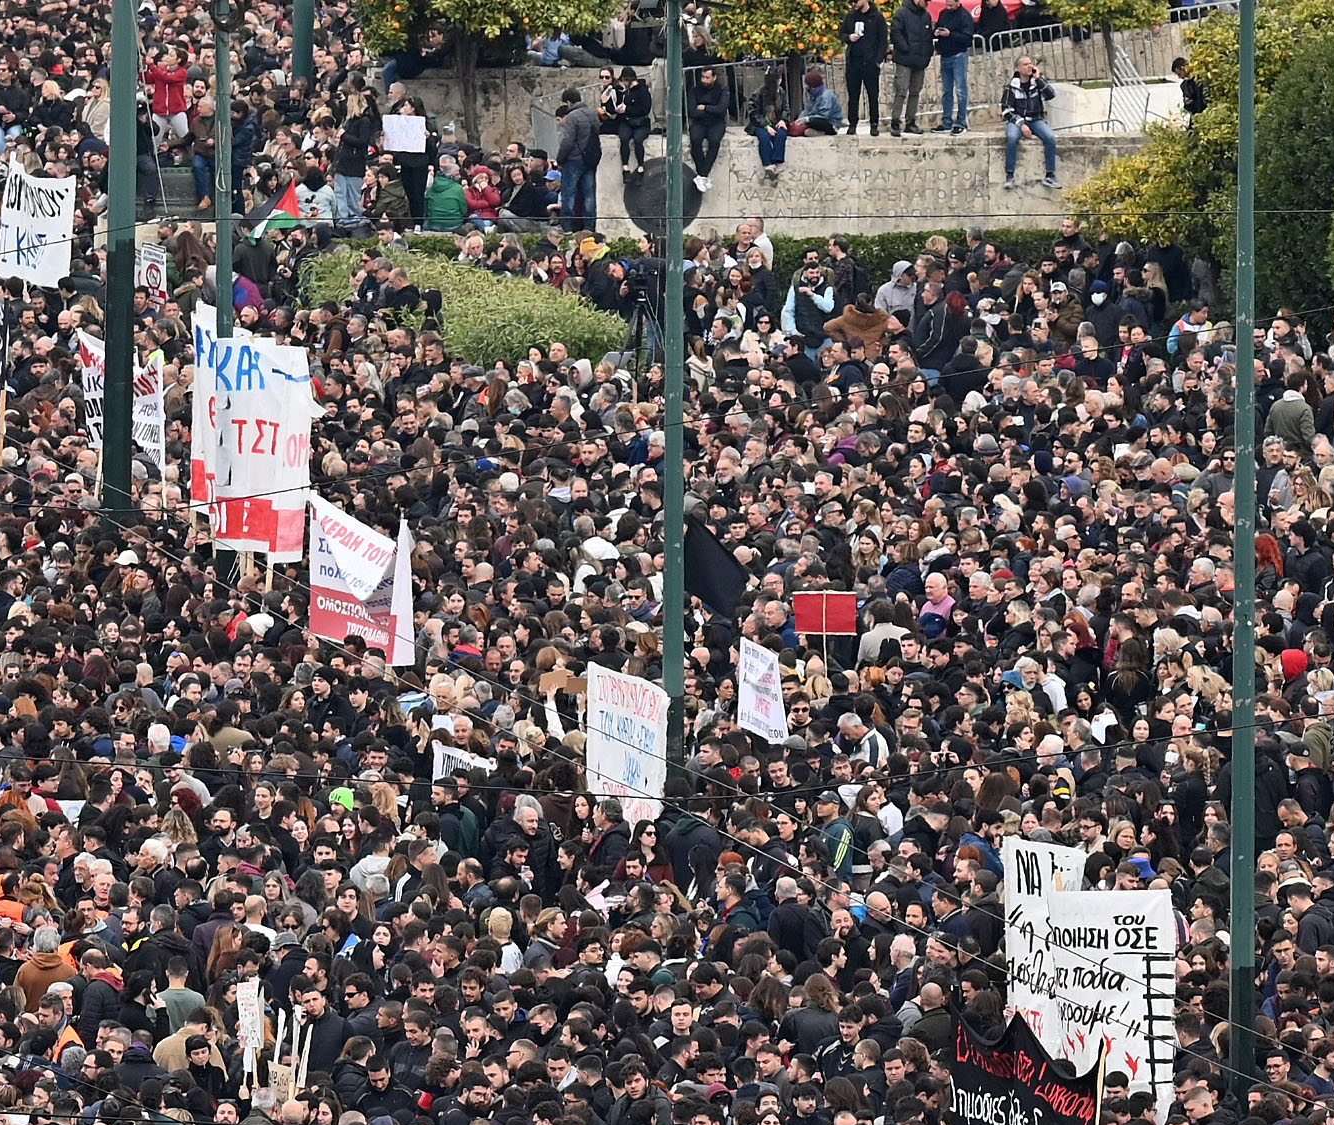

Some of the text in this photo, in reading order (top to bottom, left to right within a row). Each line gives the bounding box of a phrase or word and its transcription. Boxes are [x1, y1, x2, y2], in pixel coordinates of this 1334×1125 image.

[320, 516, 364, 553] ΚΕΡΔΗ
[1015, 849, 1043, 897] ΝΑ
[1114, 927, 1159, 951] ΟΣΕ
